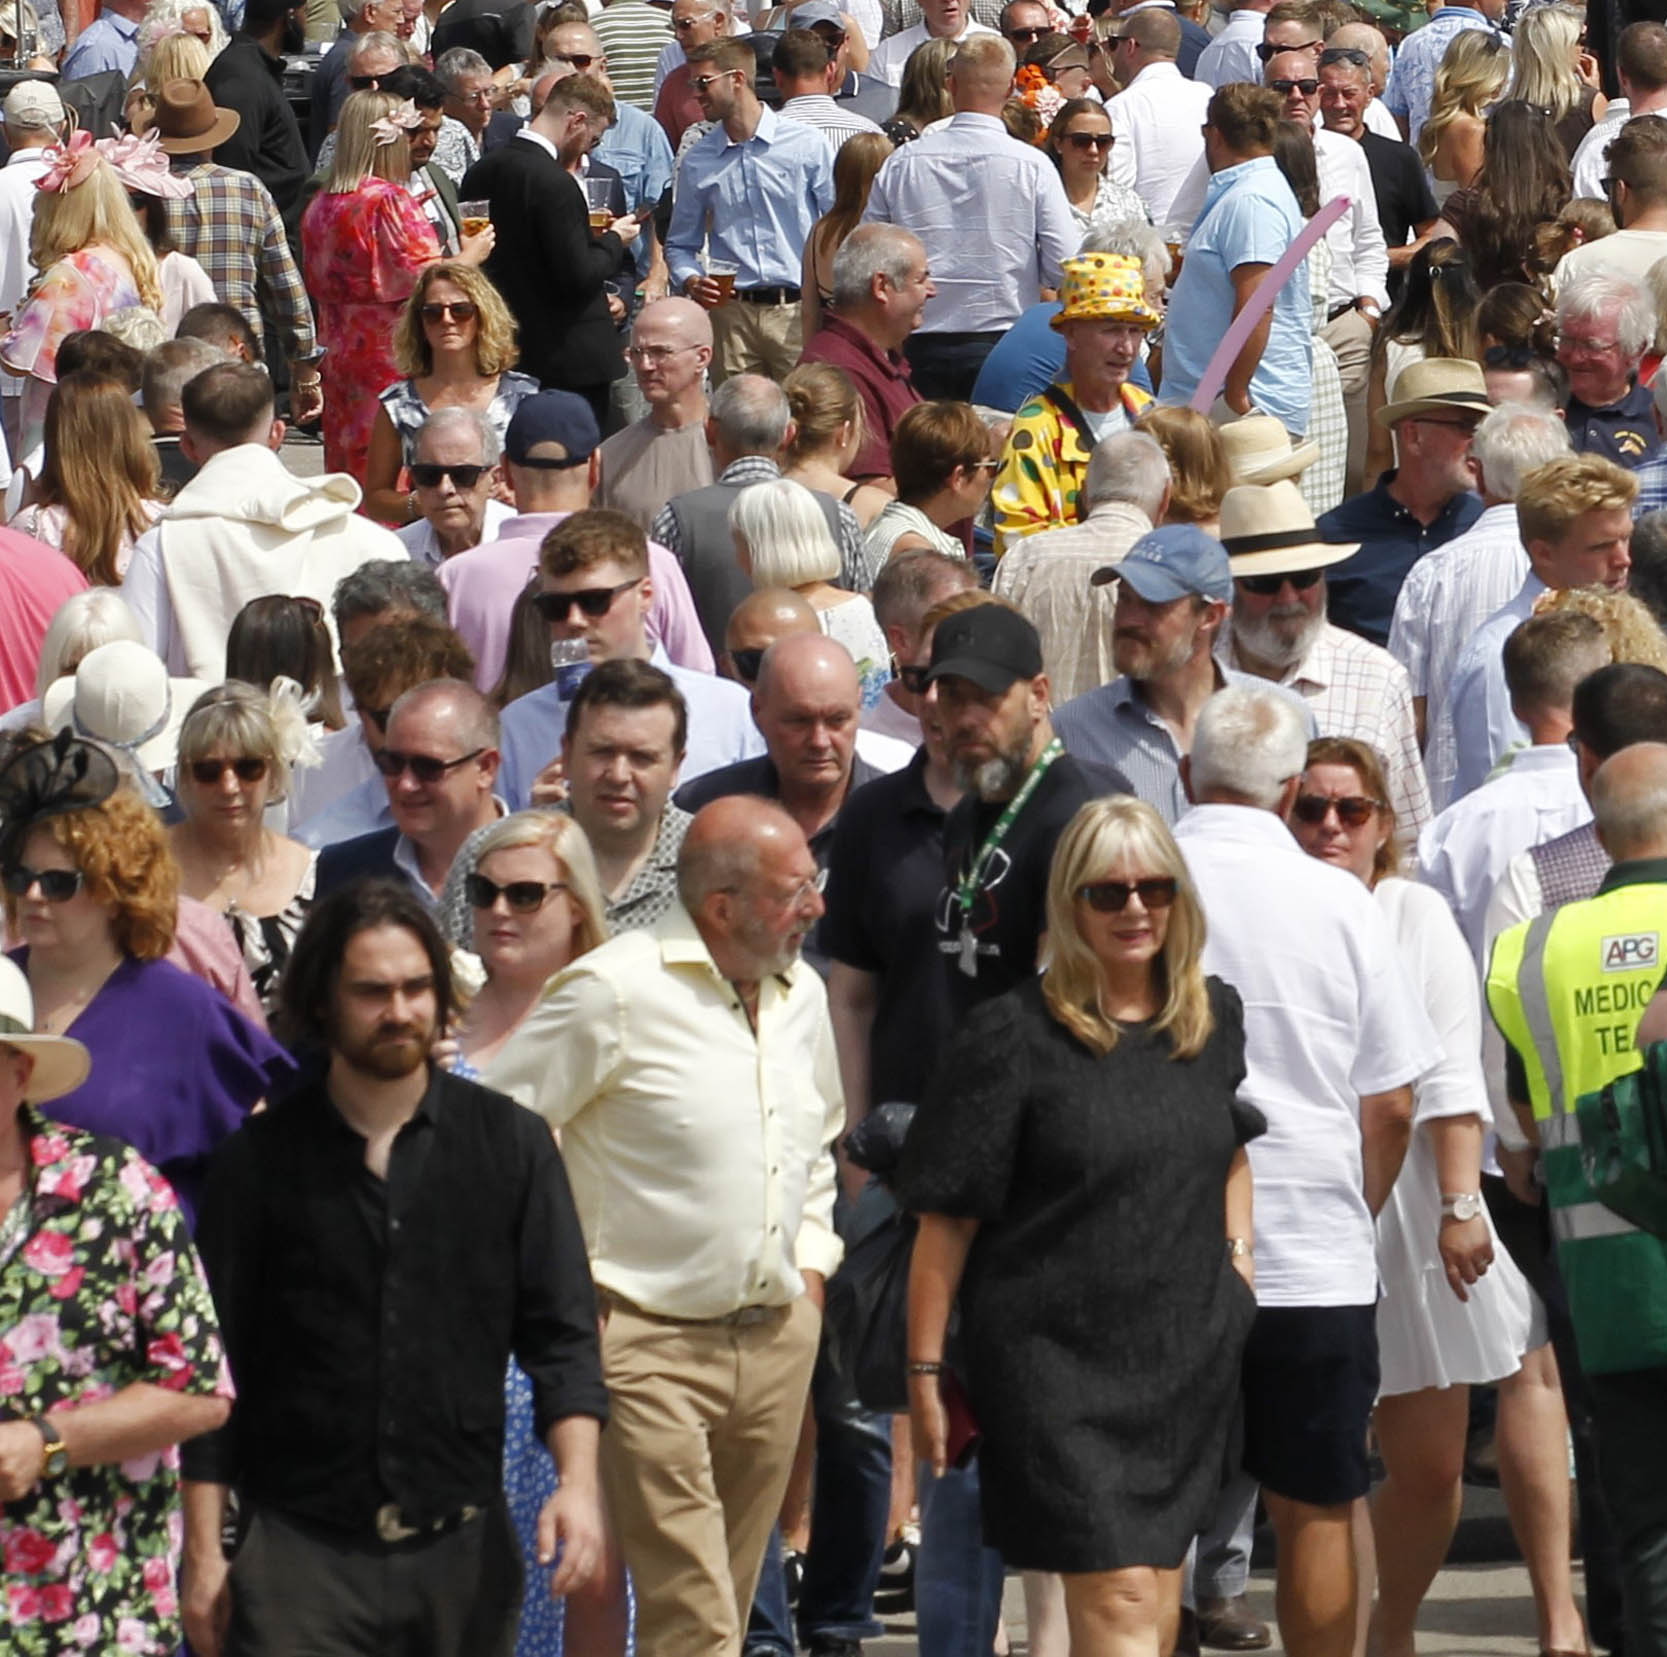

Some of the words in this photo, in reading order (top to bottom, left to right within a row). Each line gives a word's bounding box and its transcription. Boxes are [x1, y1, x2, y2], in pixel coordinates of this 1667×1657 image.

[1606, 937, 1654, 964] APG
[1574, 980, 1652, 1017] MEDIC
[1594, 1025, 1632, 1056] TE
